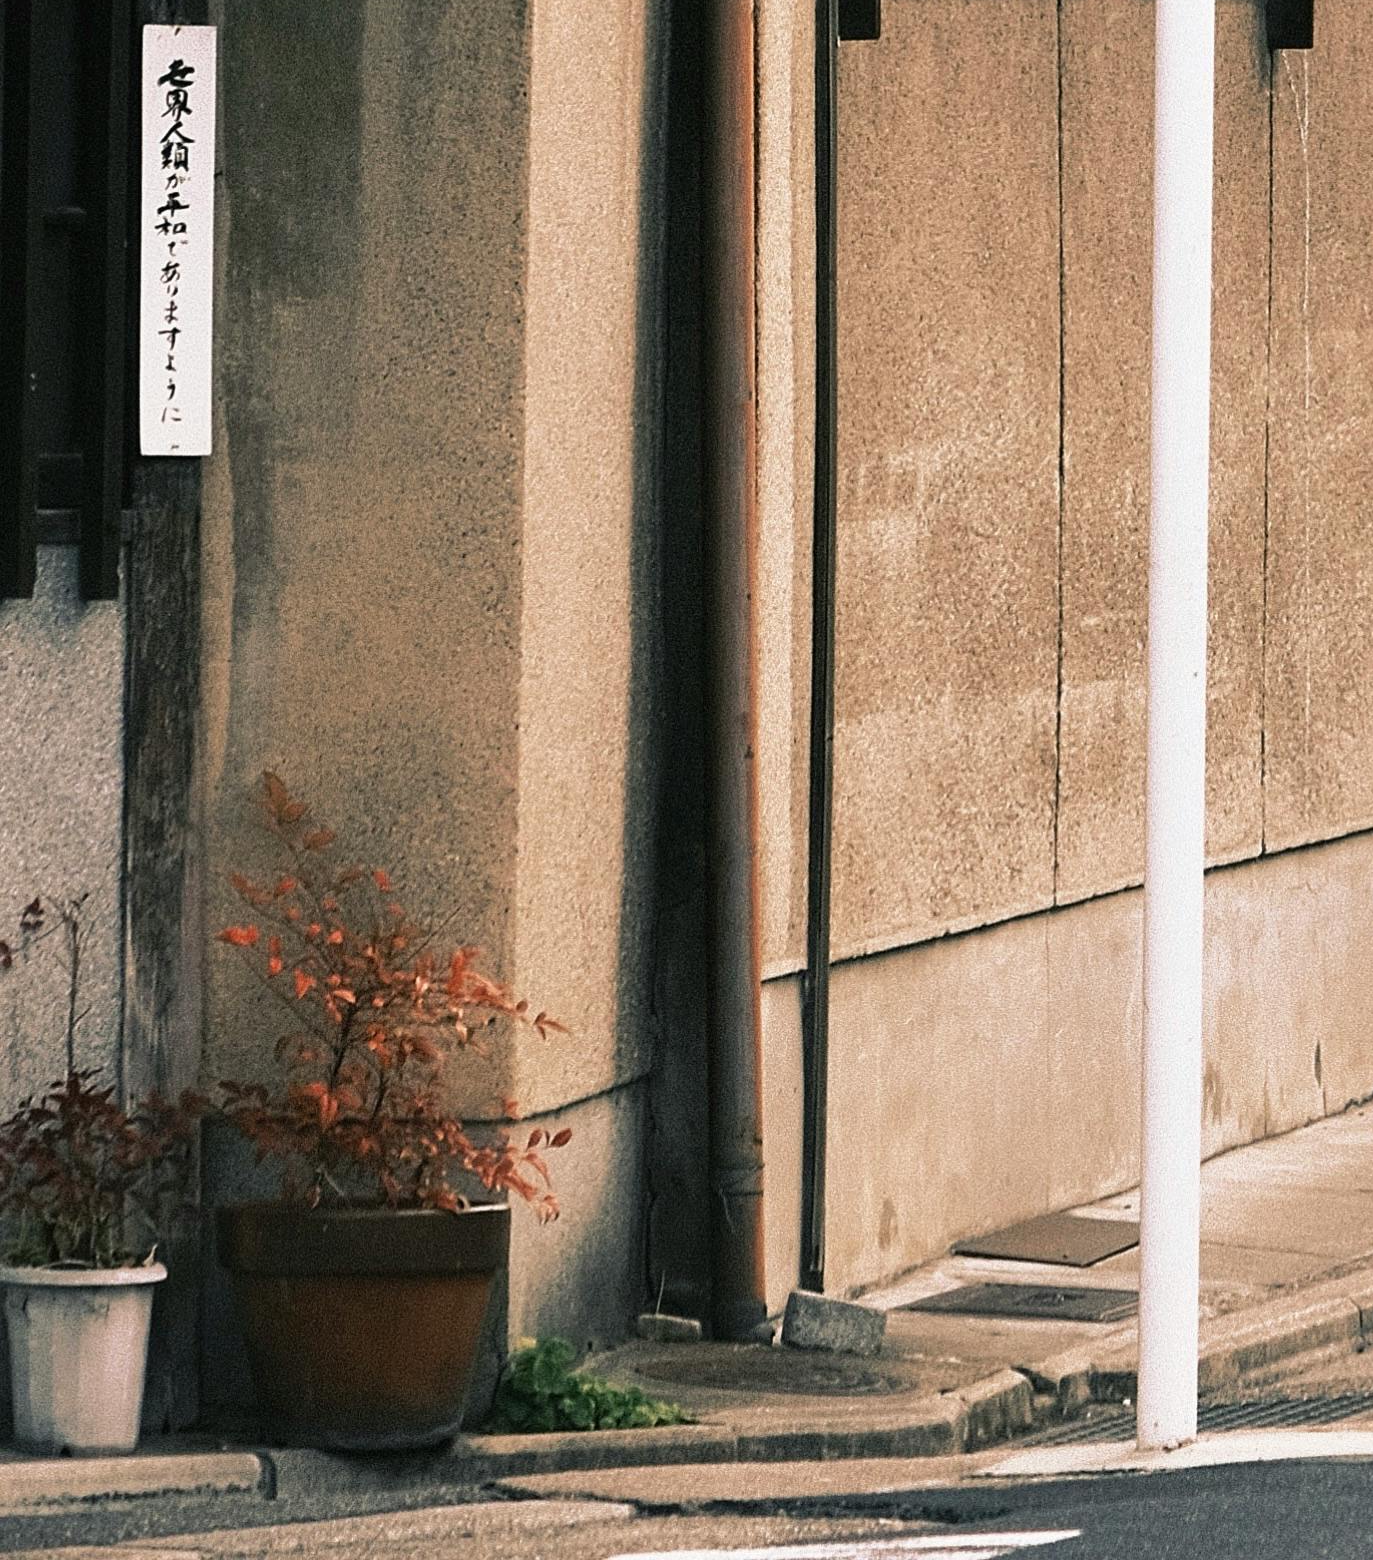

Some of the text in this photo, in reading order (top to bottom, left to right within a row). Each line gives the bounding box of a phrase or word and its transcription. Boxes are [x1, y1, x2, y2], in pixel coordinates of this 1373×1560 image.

[154, 58, 195, 424] 世界人類が平和でありますように
